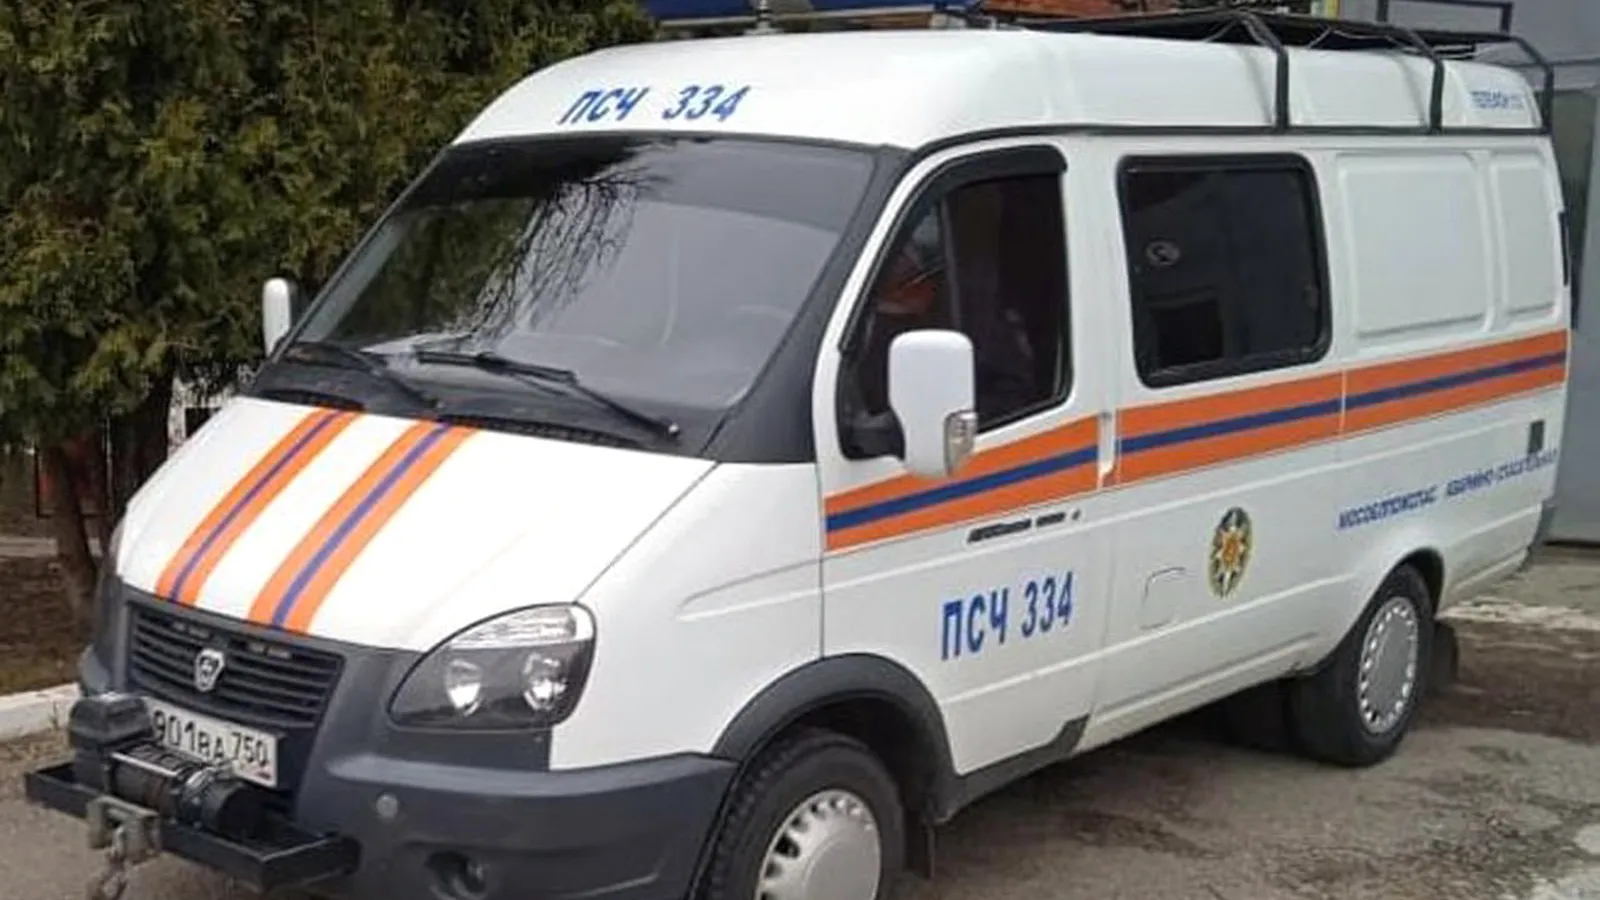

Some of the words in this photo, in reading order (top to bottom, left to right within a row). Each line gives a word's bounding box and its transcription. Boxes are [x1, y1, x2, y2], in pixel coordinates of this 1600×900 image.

[558, 86, 650, 125] ПСЧ
[662, 84, 751, 122] 334
[941, 587, 1009, 661] ПСЧ
[1021, 570, 1073, 638] 334
